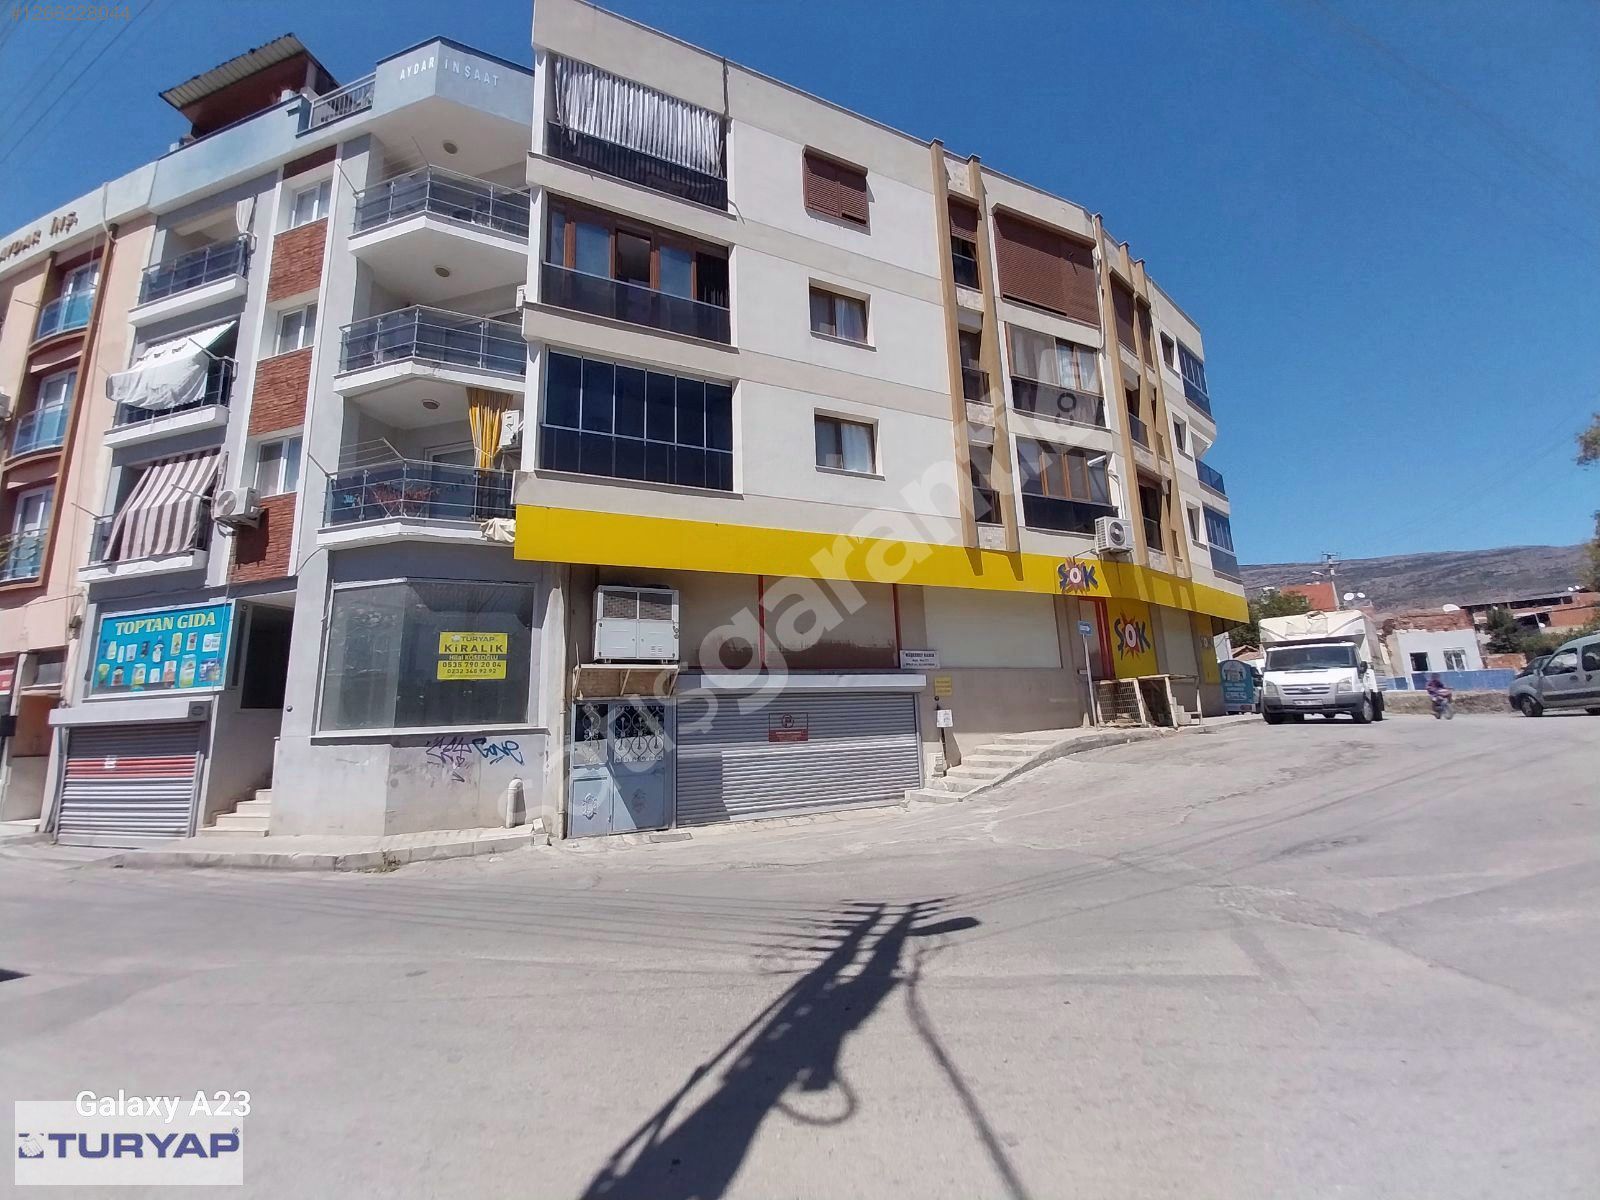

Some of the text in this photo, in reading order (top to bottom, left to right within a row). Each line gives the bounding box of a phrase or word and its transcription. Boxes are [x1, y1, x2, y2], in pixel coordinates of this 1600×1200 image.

[400, 56, 435, 81] AYDAR
[115, 611, 216, 636] TOPTAN GIDA
